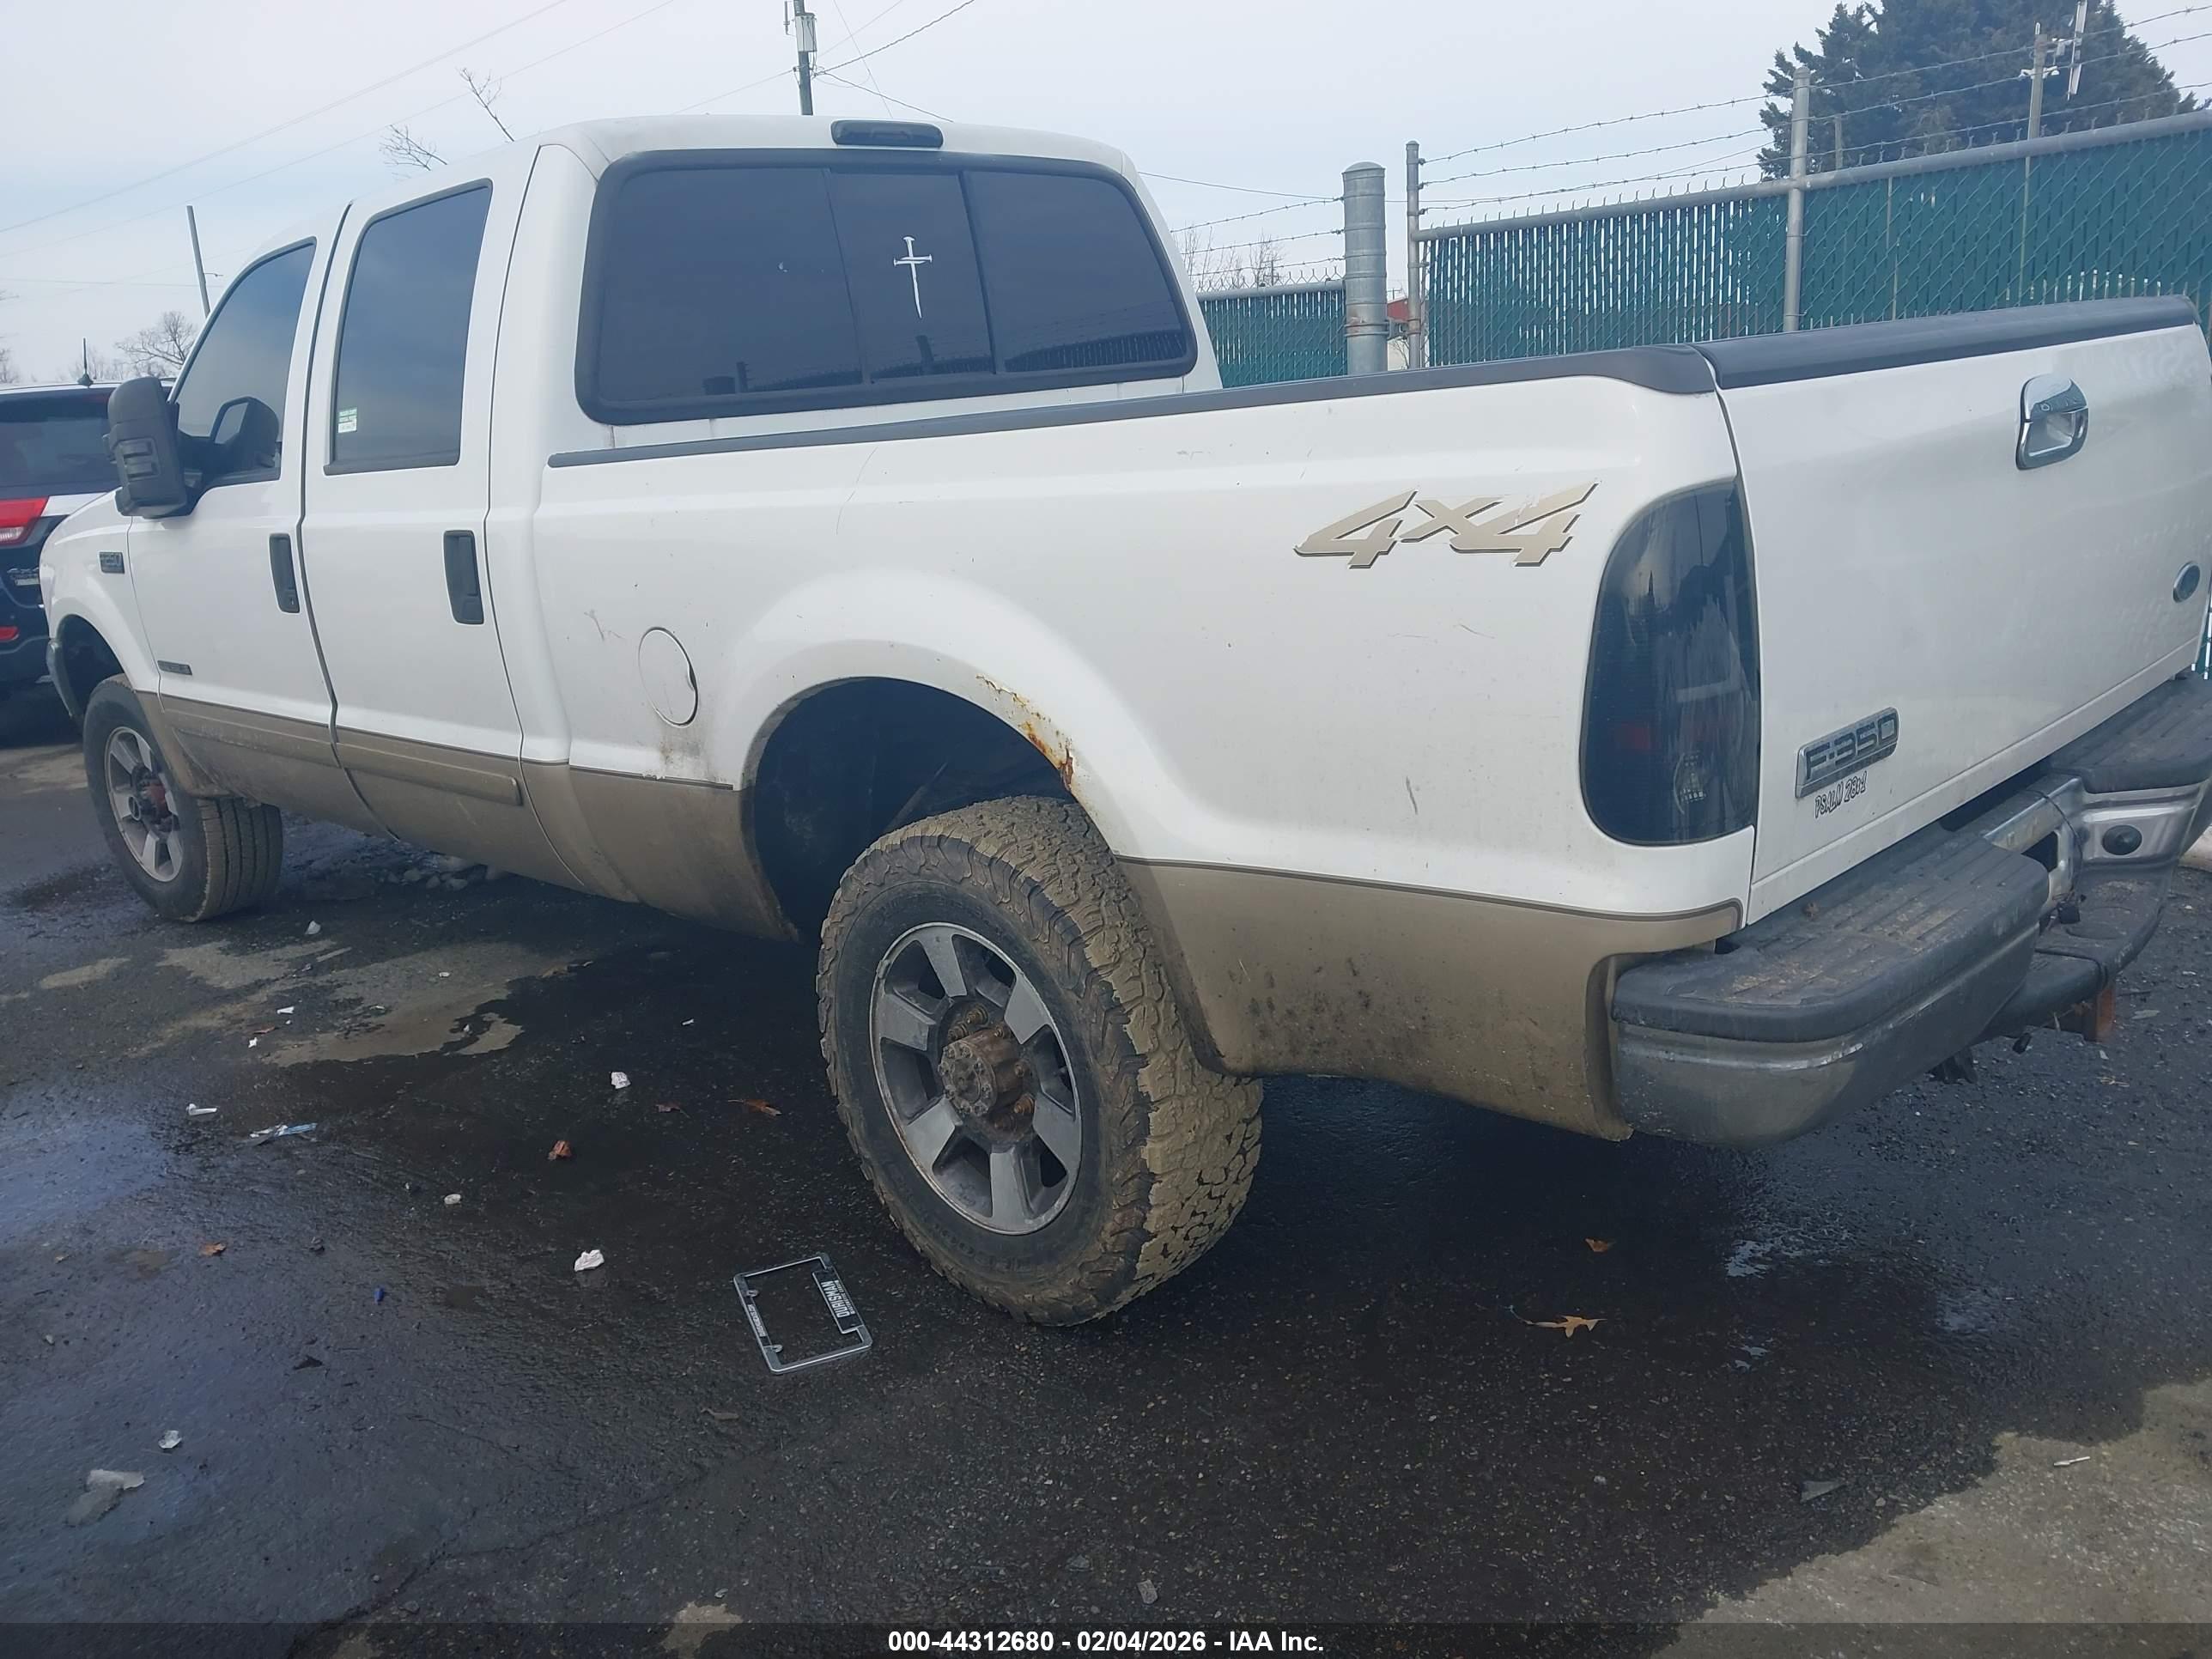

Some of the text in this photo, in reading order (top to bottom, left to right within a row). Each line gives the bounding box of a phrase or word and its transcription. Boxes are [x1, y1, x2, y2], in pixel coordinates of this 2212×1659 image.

[1804, 712, 1899, 781] F-350
[1814, 780, 1845, 819] PSALM
[820, 1279, 851, 1318] OURISMAN
